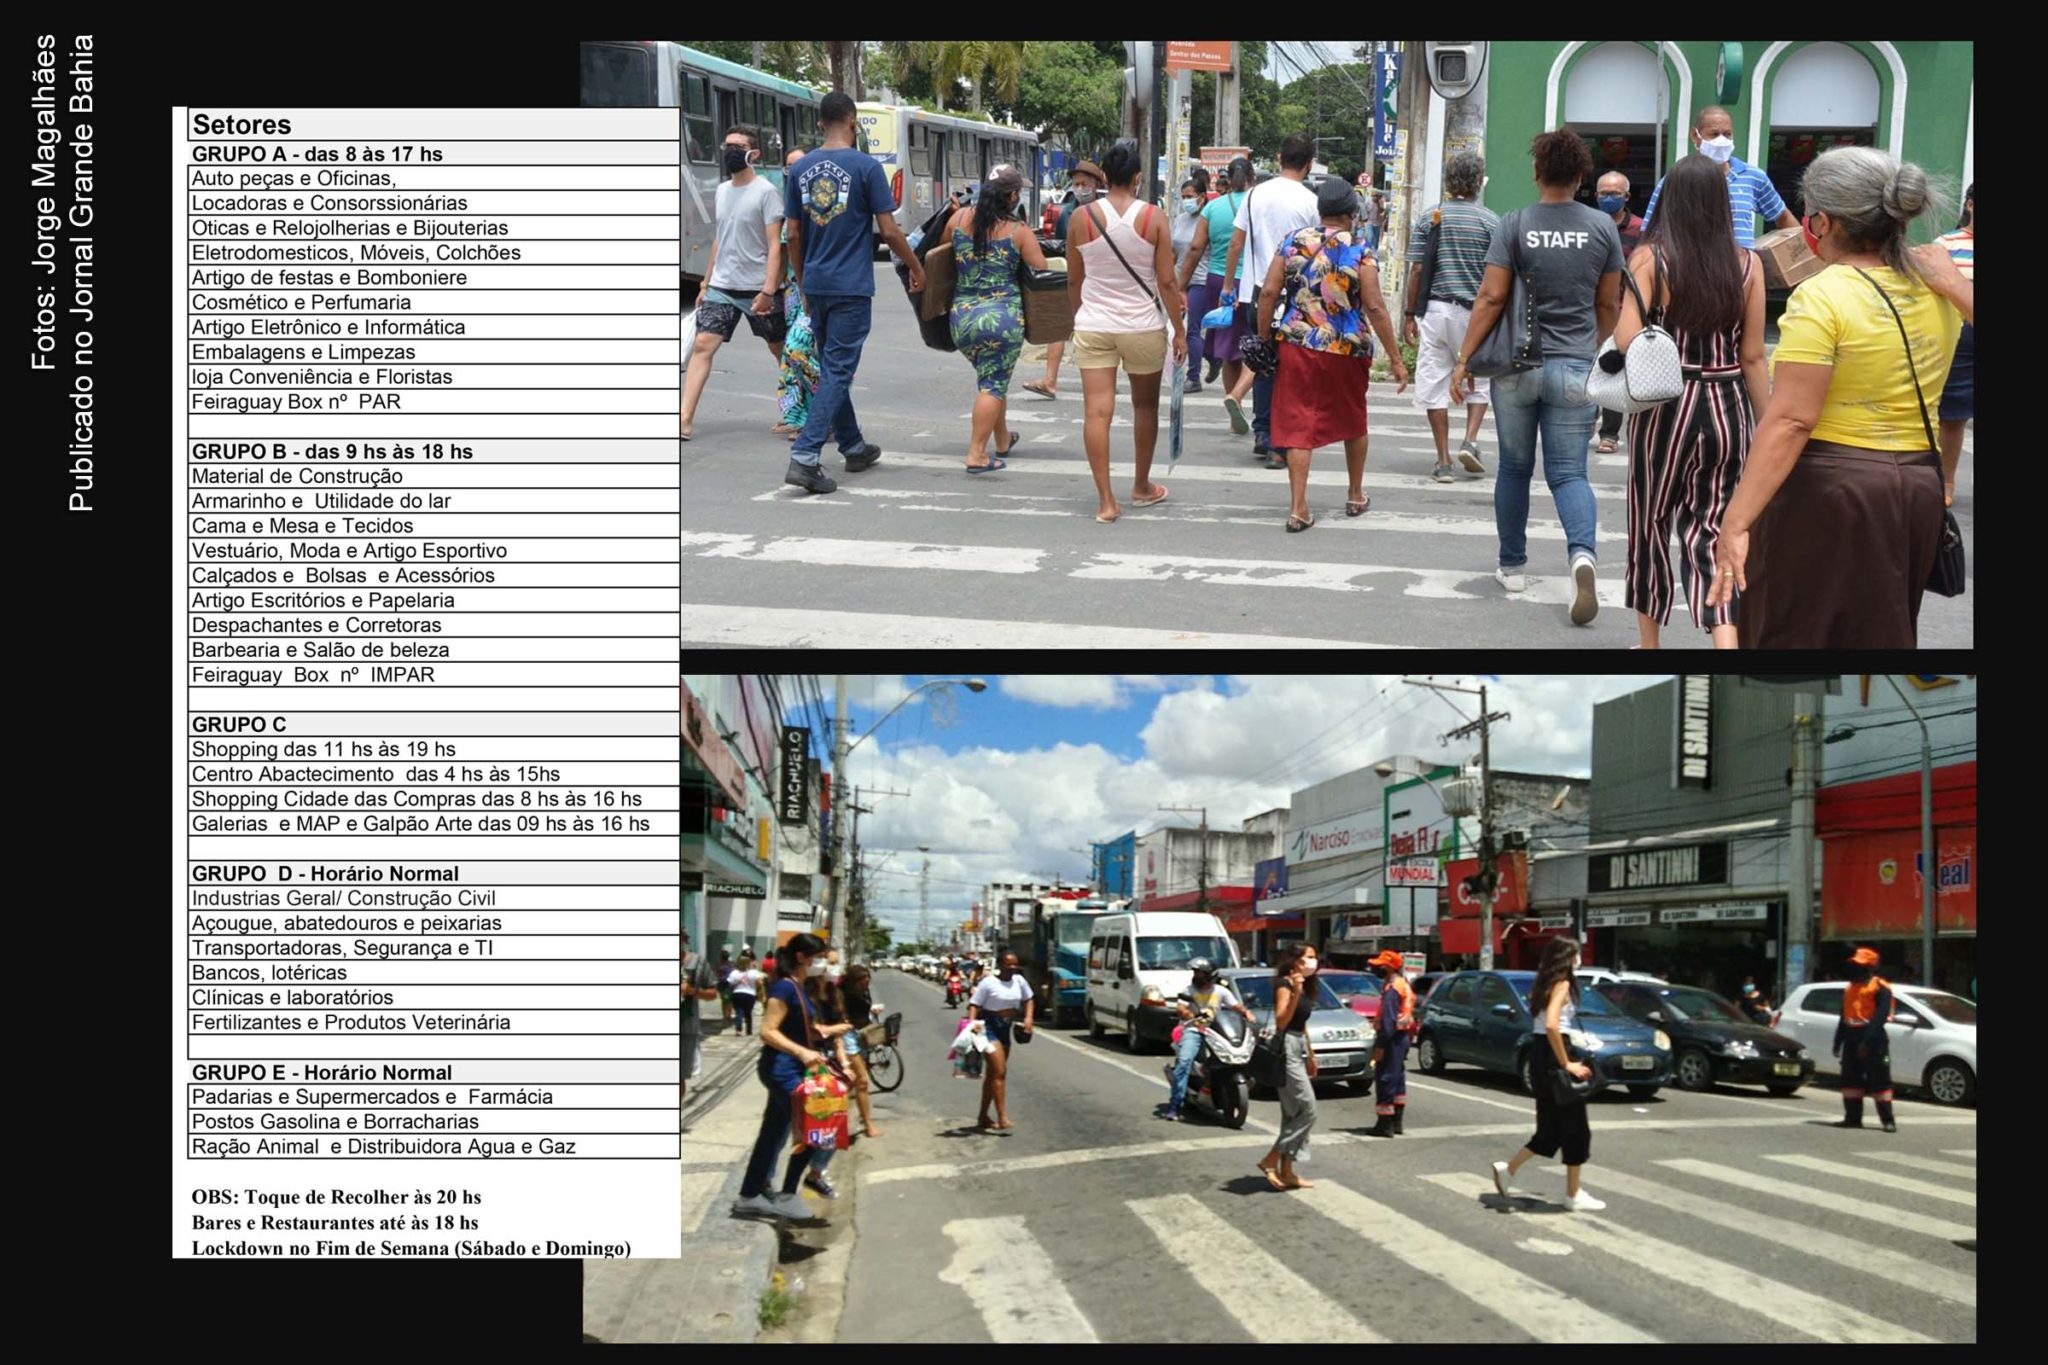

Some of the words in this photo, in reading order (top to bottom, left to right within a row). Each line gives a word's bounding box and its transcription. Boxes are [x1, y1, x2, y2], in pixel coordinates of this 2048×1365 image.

[1526, 230, 1589, 249] STAFF
[1683, 675, 1709, 756] SANTINN
[787, 731, 801, 820] RIACHUELO
[1310, 829, 1349, 852] Narciso
[1390, 866, 1435, 880] MUNDIAL
[706, 883, 766, 895] RIACHUELO
